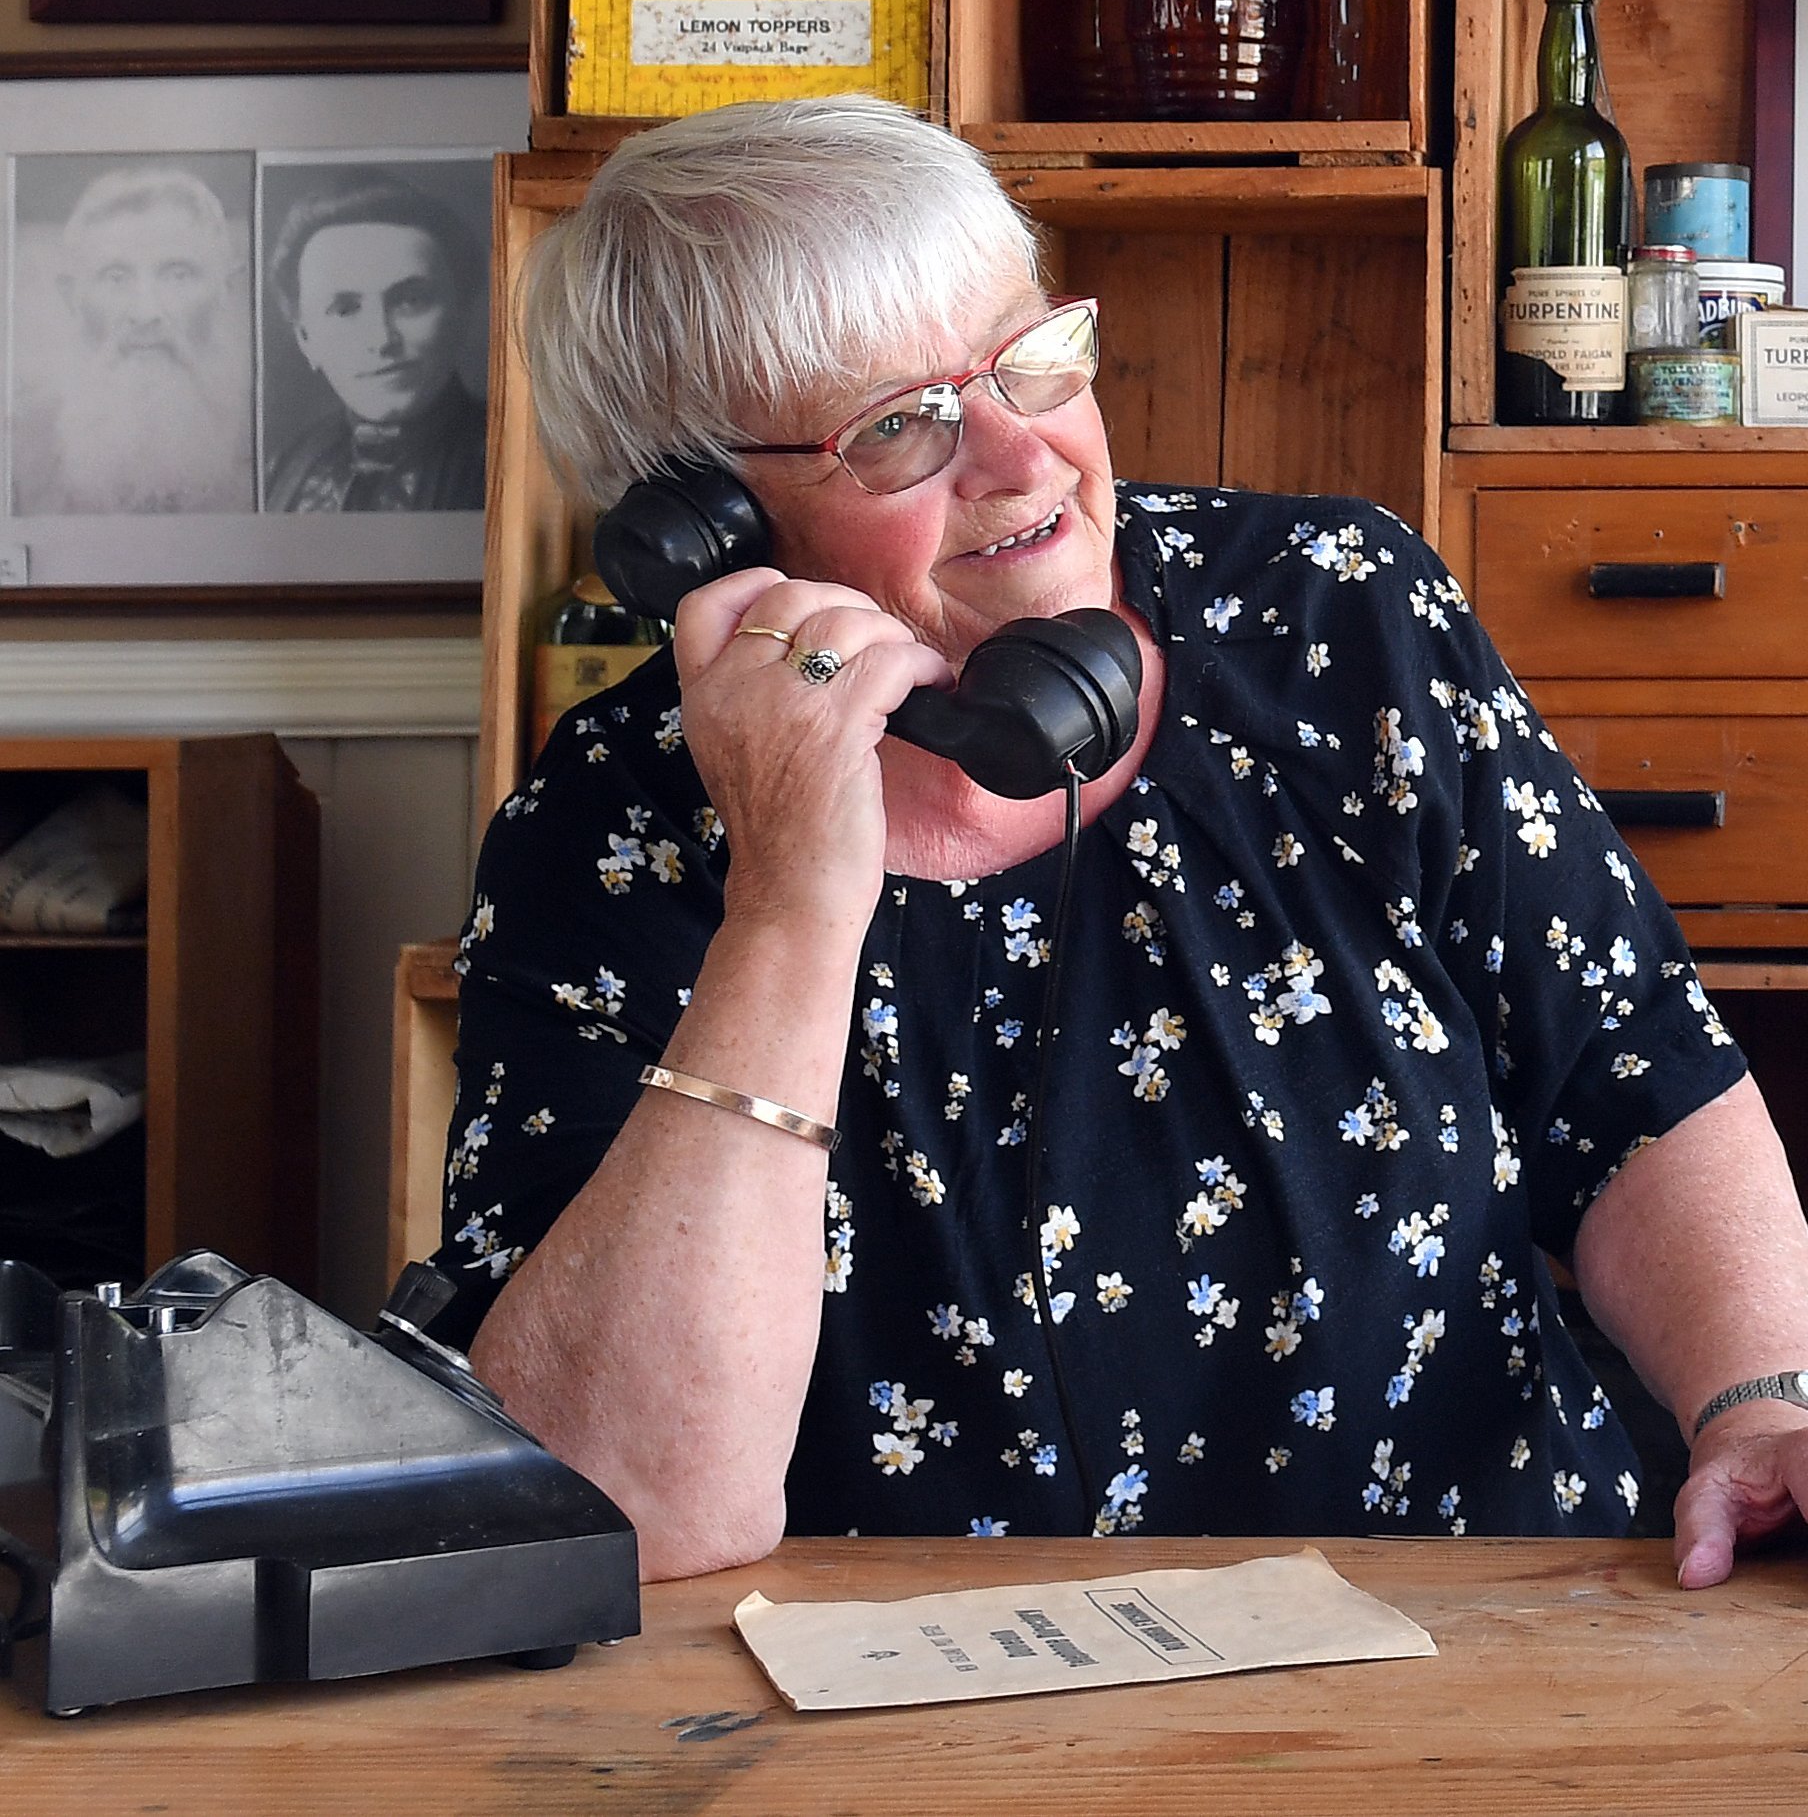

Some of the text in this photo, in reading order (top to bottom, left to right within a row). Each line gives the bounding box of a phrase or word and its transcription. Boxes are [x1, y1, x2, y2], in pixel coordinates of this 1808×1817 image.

[679, 19, 832, 34] LEMON TOPPERS
[701, 41, 717, 53] 24
[1508, 302, 1620, 320] TURPENTINE
[1573, 349, 1613, 360] FAIGAN
